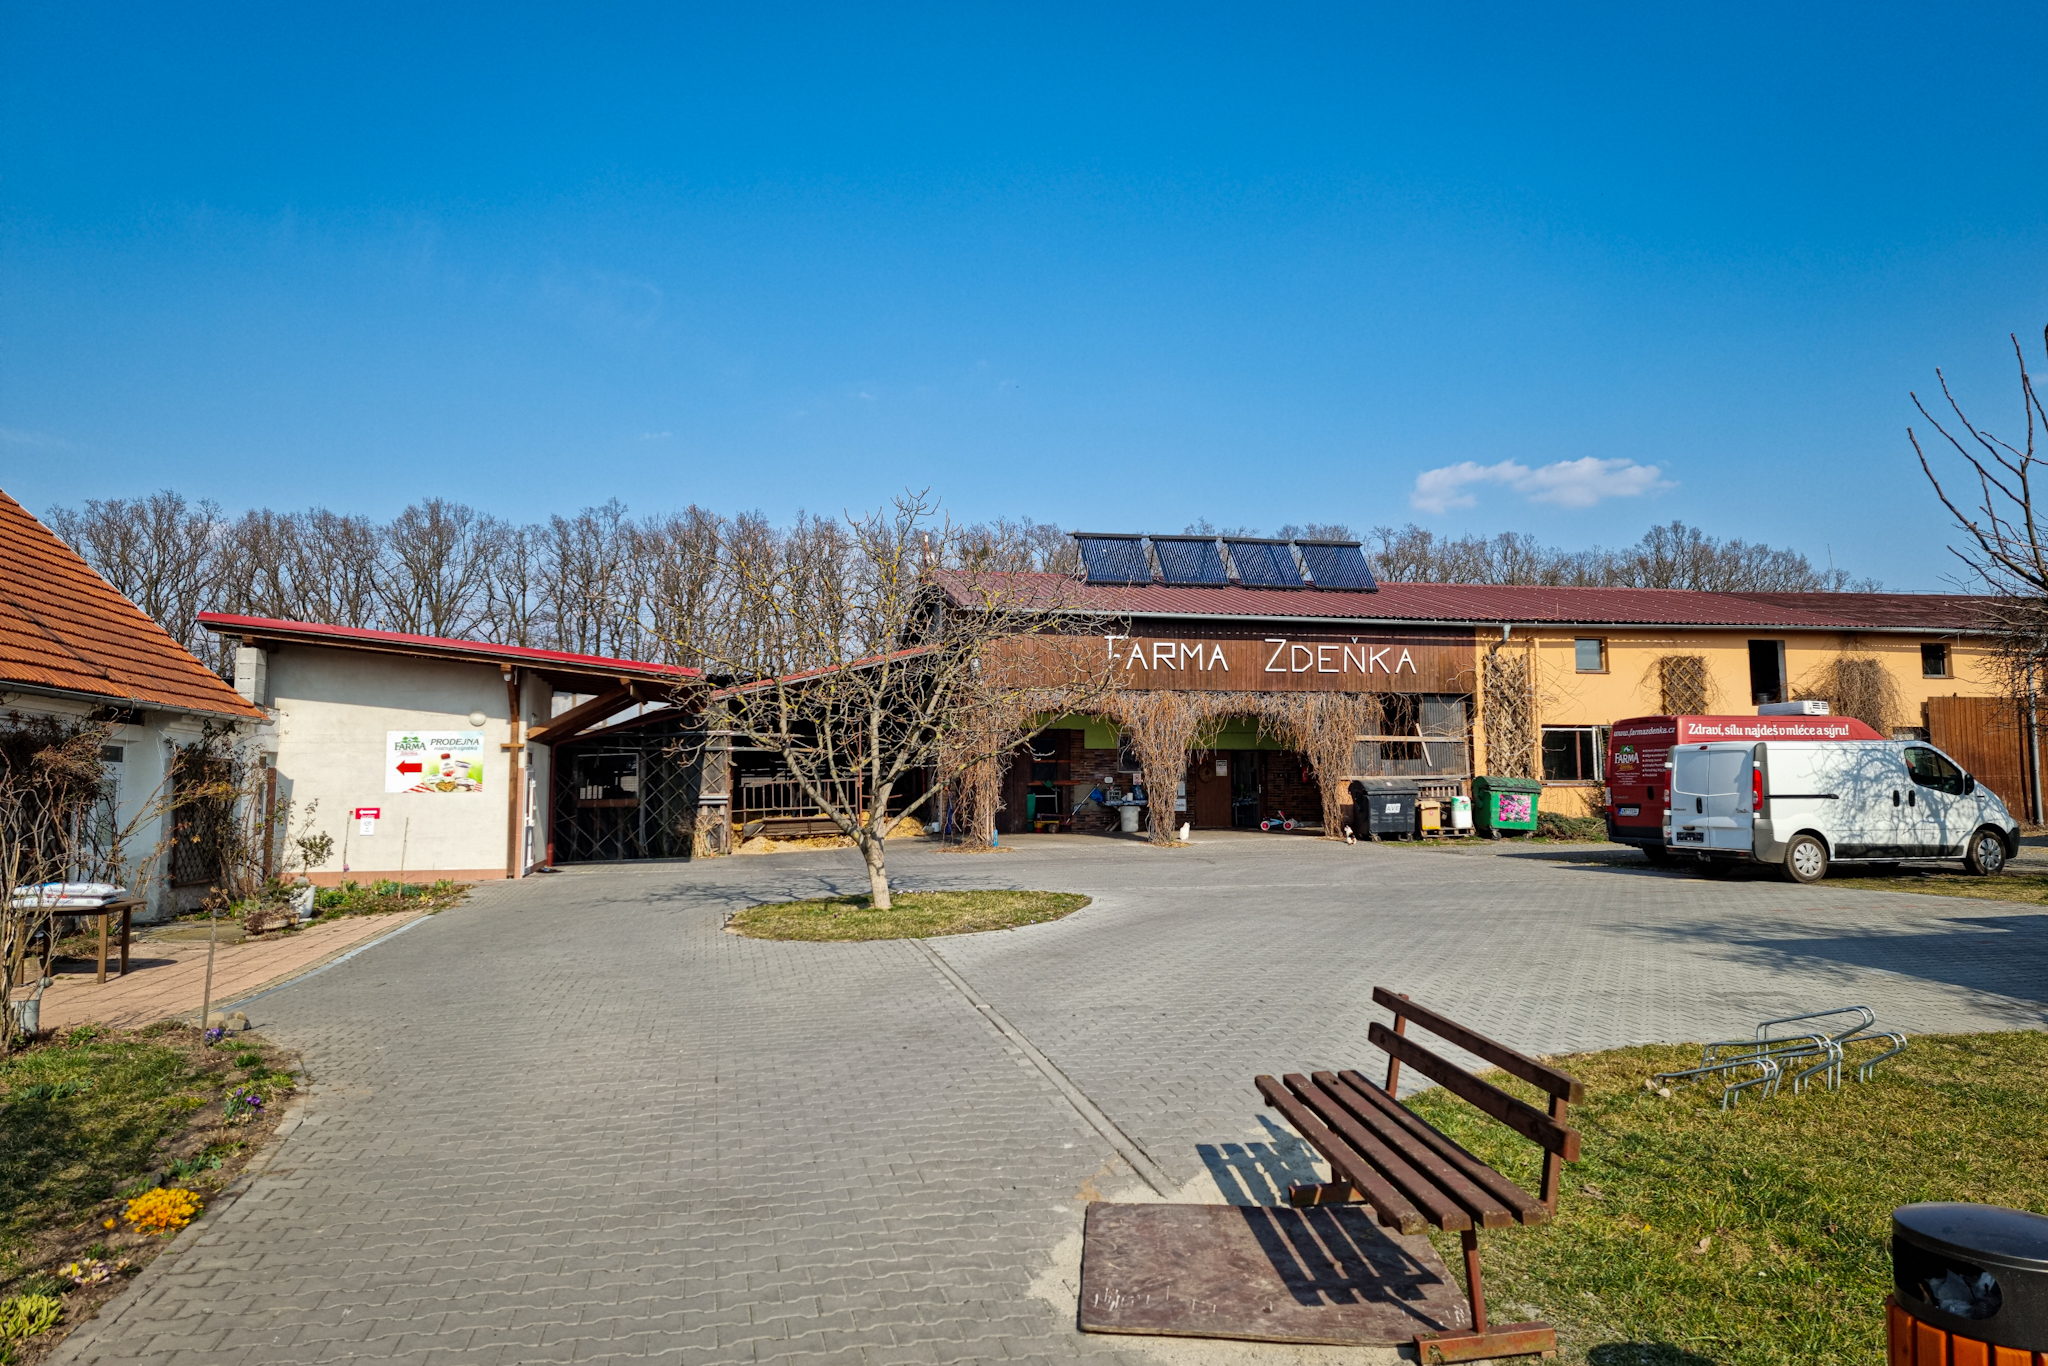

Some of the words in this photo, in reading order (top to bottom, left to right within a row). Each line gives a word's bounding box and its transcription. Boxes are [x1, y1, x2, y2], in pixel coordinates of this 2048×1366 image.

[1104, 635, 1229, 671] FARMA
[1264, 637, 1417, 674] ZDEŇKA
[1613, 726, 1676, 737] www.farmazdenka.cz
[1688, 723, 1724, 737] Zdraví,
[1725, 723, 1743, 736] sílu
[1744, 723, 1778, 738] najdeš
[1779, 726, 1786, 735] v
[1786, 724, 1815, 736] mléce
[1816, 727, 1823, 736] a
[1824, 724, 1849, 739] sýru!
[394, 741, 427, 751] FARMA
[430, 738, 480, 746] PRODEJNA
[1614, 752, 1640, 764] FARMA
